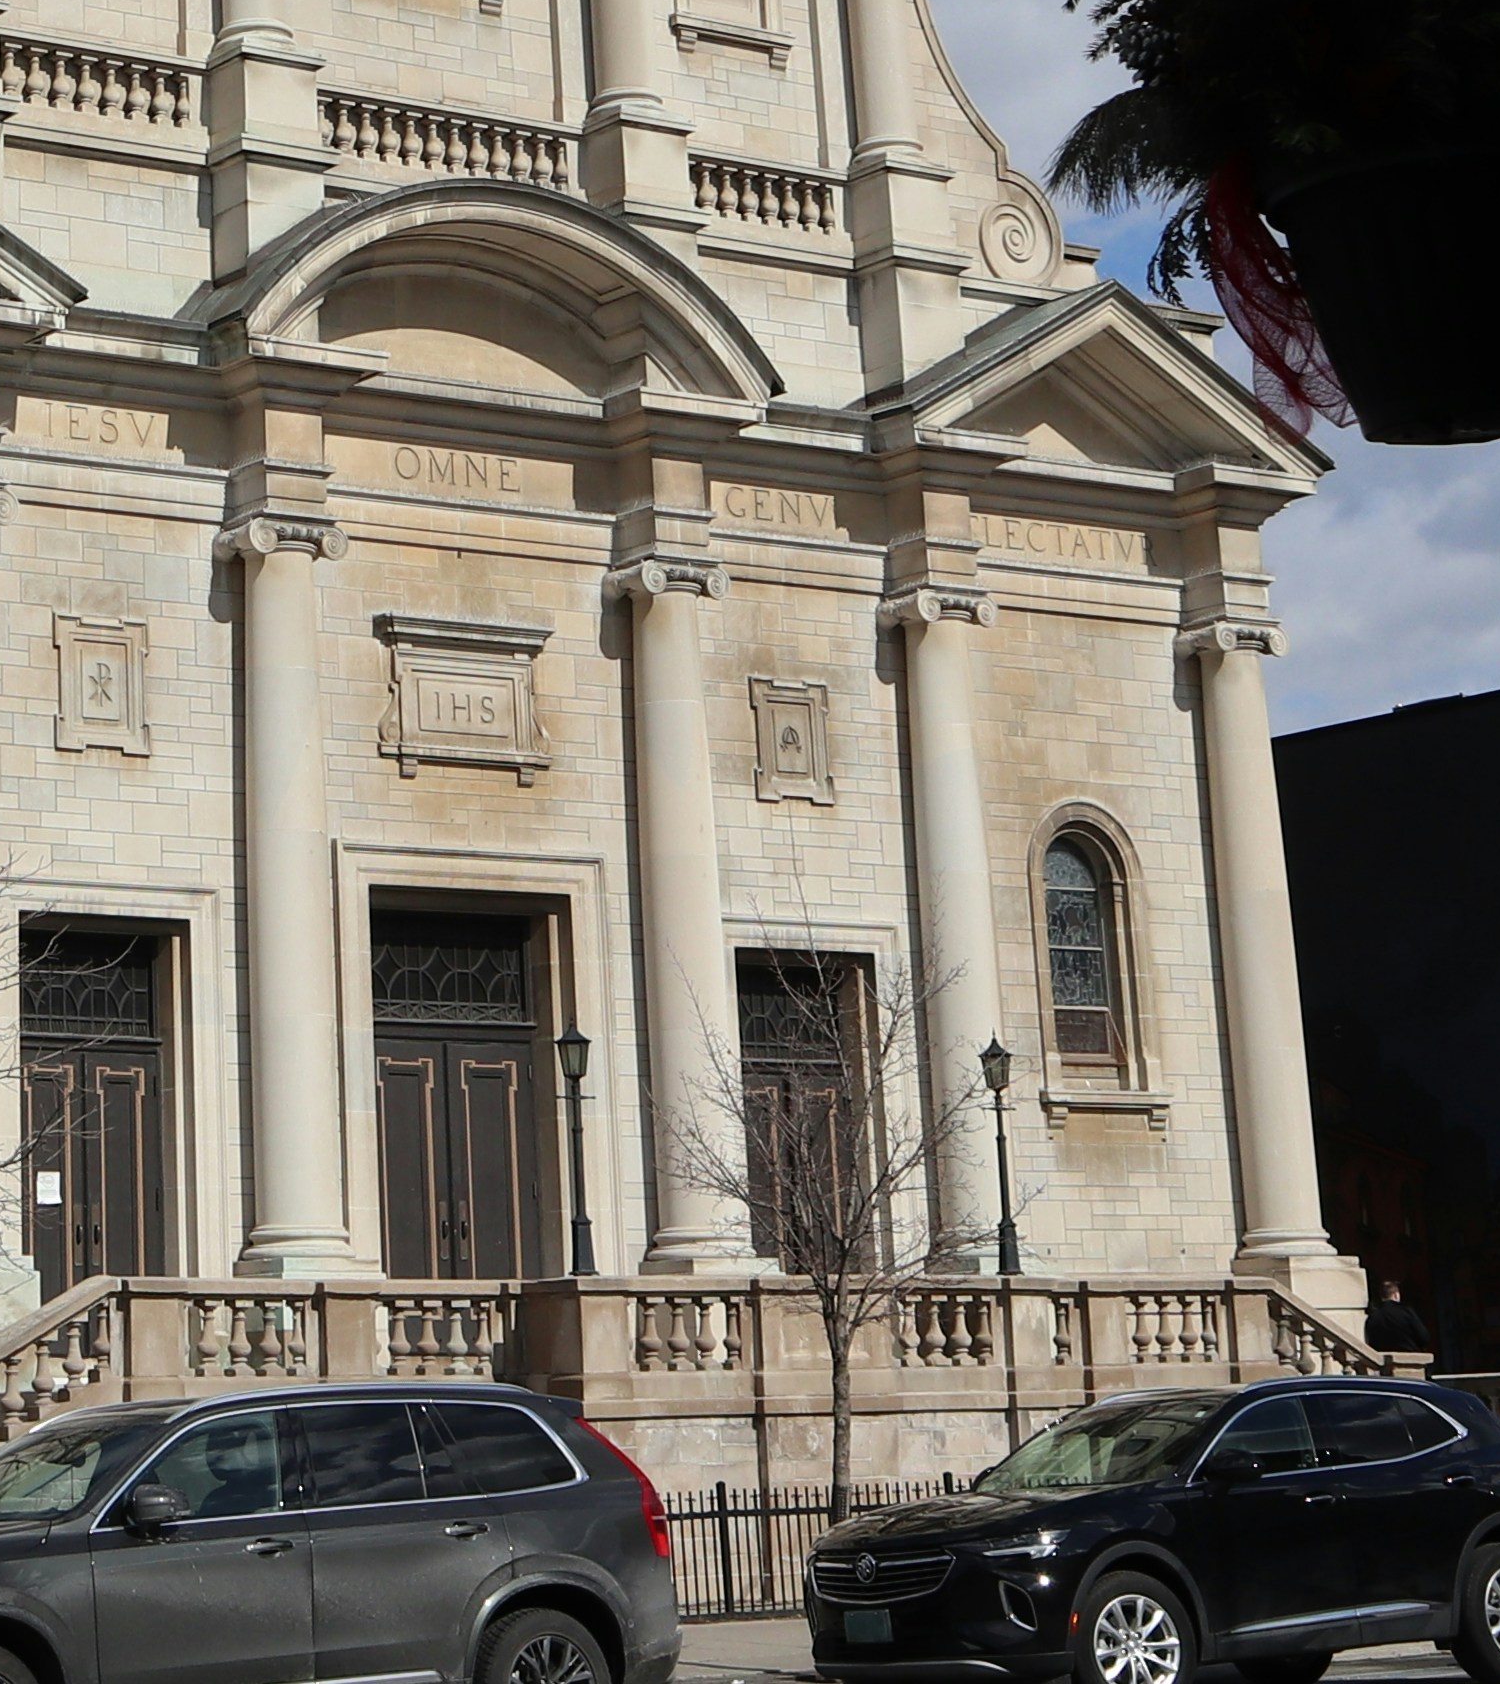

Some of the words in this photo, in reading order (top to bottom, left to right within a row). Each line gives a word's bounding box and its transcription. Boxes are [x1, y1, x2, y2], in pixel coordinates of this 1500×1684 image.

[43, 402, 154, 448] IESV
[393, 446, 520, 493] OMNE
[725, 486, 835, 526] GENV
[434, 690, 496, 725] IHS
